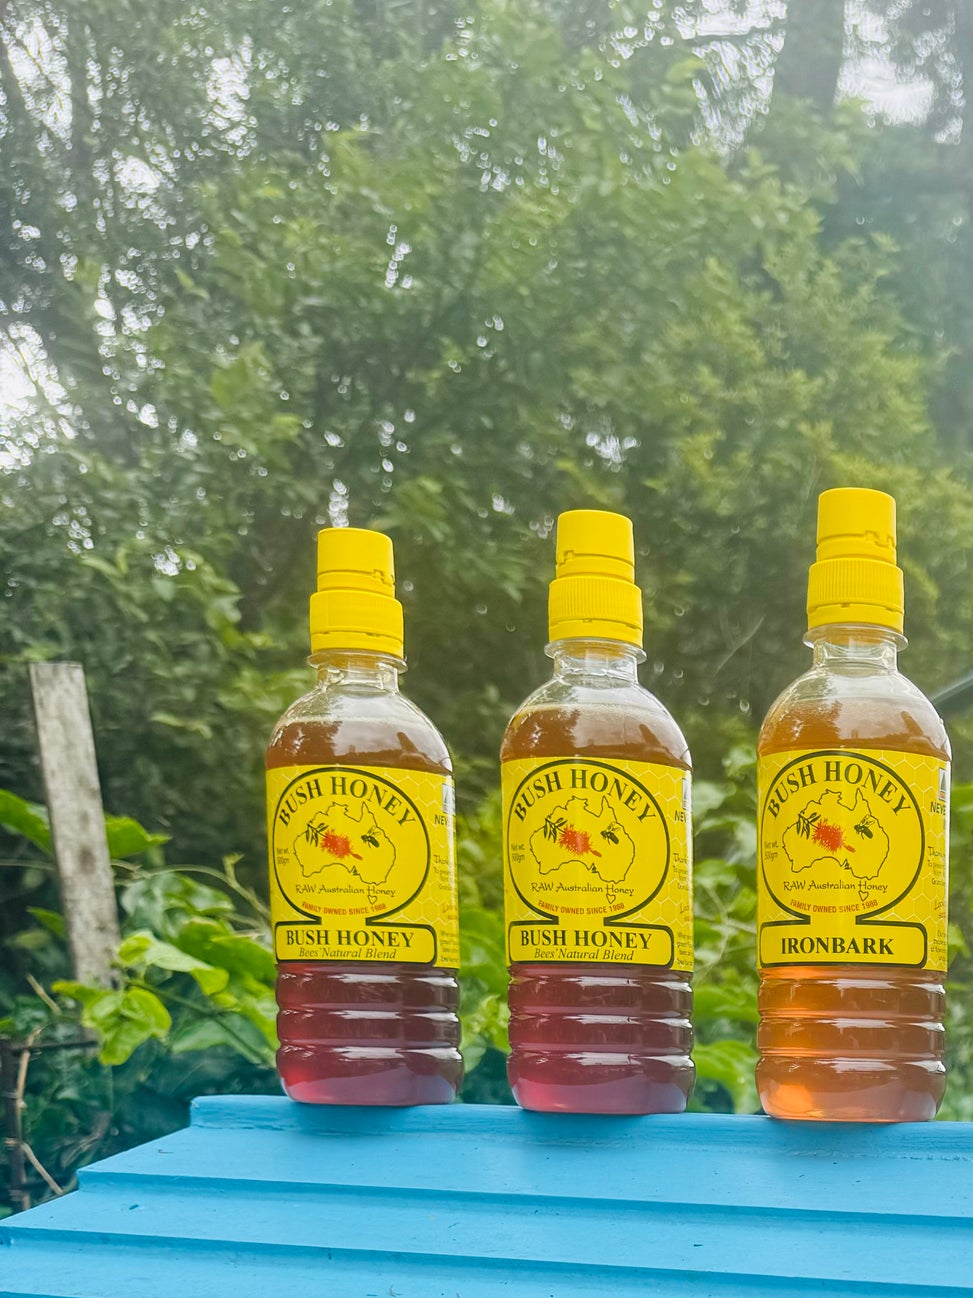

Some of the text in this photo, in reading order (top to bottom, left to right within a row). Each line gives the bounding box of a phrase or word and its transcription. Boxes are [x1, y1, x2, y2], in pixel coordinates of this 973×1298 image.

[513, 768, 656, 824] BUSH HONEY
[767, 761, 911, 820] BUSH HONEY
[279, 776, 416, 827] BUSH HONEY
[295, 883, 396, 898] RAW Australian Honey
[531, 882, 635, 897] RAW Australian Honey
[783, 879, 888, 893] RAW Australian Honey
[302, 901, 322, 913] FAMILY
[323, 906, 347, 915] OWNED
[349, 906, 369, 915] SINCE
[537, 900, 559, 912] FAMILY
[560, 905, 584, 915] OWNED
[586, 905, 607, 914] SINCE
[790, 899, 811, 911] FAMILY
[812, 905, 837, 913] OWNED
[838, 903, 860, 913] SINCE
[286, 930, 415, 948] BUSH HONEY
[520, 929, 653, 950] BUSH HONEY
[781, 936, 894, 955] IRONBARK
[324, 947, 362, 959] Natural
[364, 948, 397, 959] Blend
[559, 948, 600, 960] Natural
[603, 950, 634, 961] Blend
